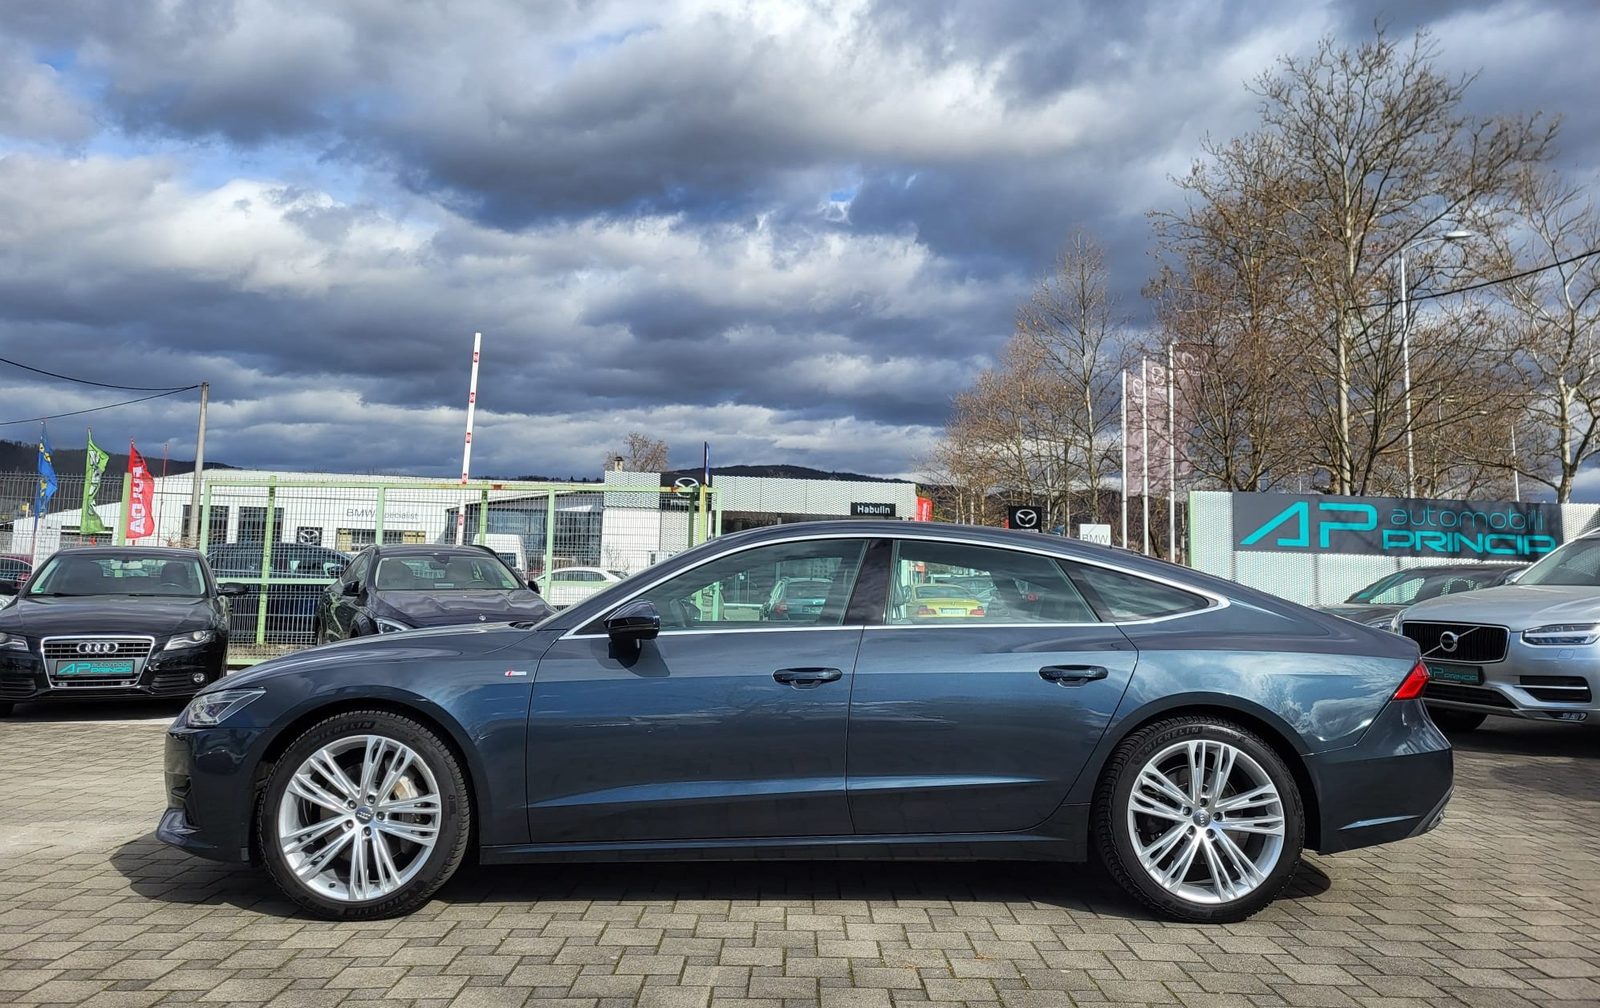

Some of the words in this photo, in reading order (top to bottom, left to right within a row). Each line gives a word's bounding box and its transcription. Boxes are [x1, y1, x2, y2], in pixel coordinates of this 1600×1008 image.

[346, 508, 375, 518] BMW
[384, 512, 419, 520] pecialist
[857, 505, 890, 514] Habulin
[1240, 501, 1377, 548] AP
[1391, 508, 1543, 530] automobili
[1082, 533, 1108, 544] BMW
[1382, 529, 1556, 555] PRINCIP
[59, 663, 91, 673] AP
